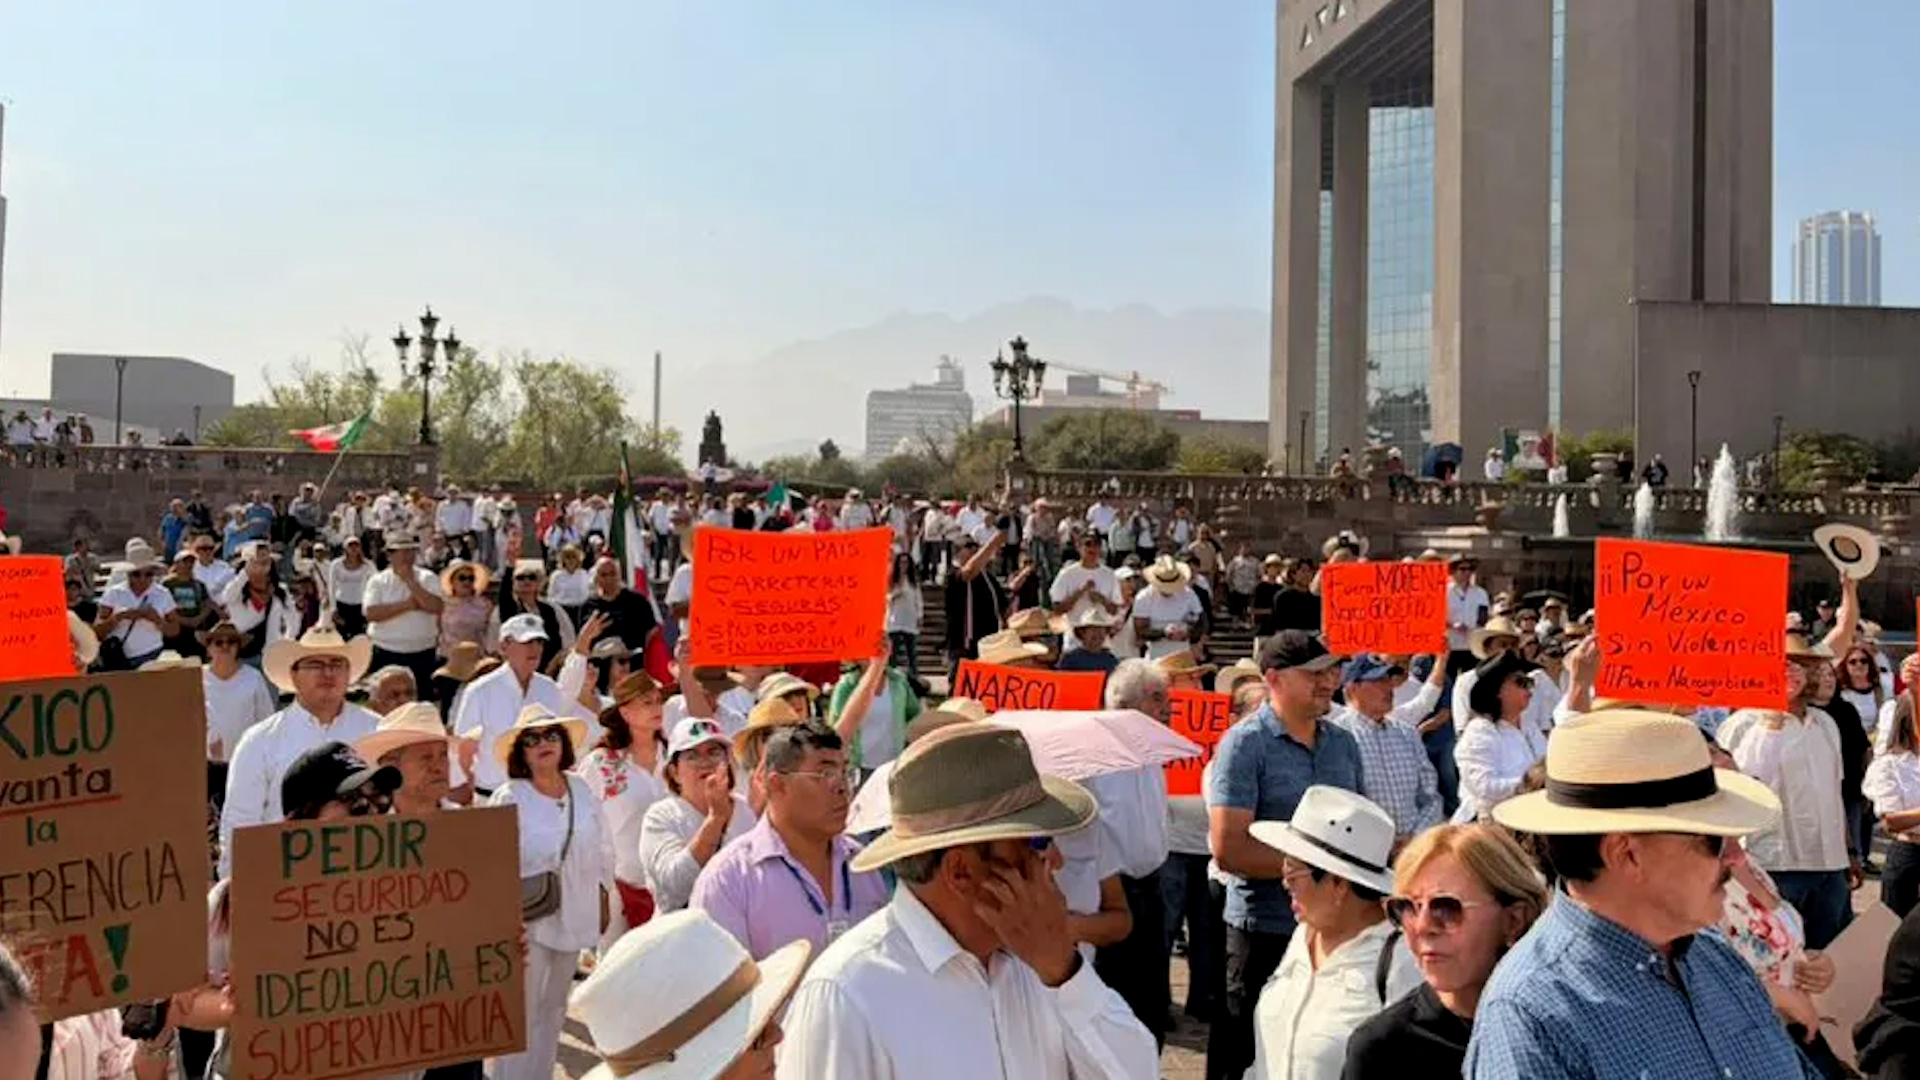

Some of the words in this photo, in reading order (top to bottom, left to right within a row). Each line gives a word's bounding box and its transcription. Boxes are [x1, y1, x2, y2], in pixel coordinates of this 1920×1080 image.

[771, 546, 800, 564] UN
[706, 574, 858, 594] CARRETERAS
[1638, 593, 1746, 625] México
[961, 669, 1057, 711] NARCO
[26, 814, 58, 847] la
[281, 819, 428, 879] PEDIR
[271, 869, 470, 922] SEGURIDAD
[306, 920, 359, 955] NO
[373, 913, 415, 944] ES
[256, 942, 454, 1019] IDEOLOGÍA
[476, 940, 512, 985] ES
[248, 991, 514, 1080] SUPERVIVENCIA
